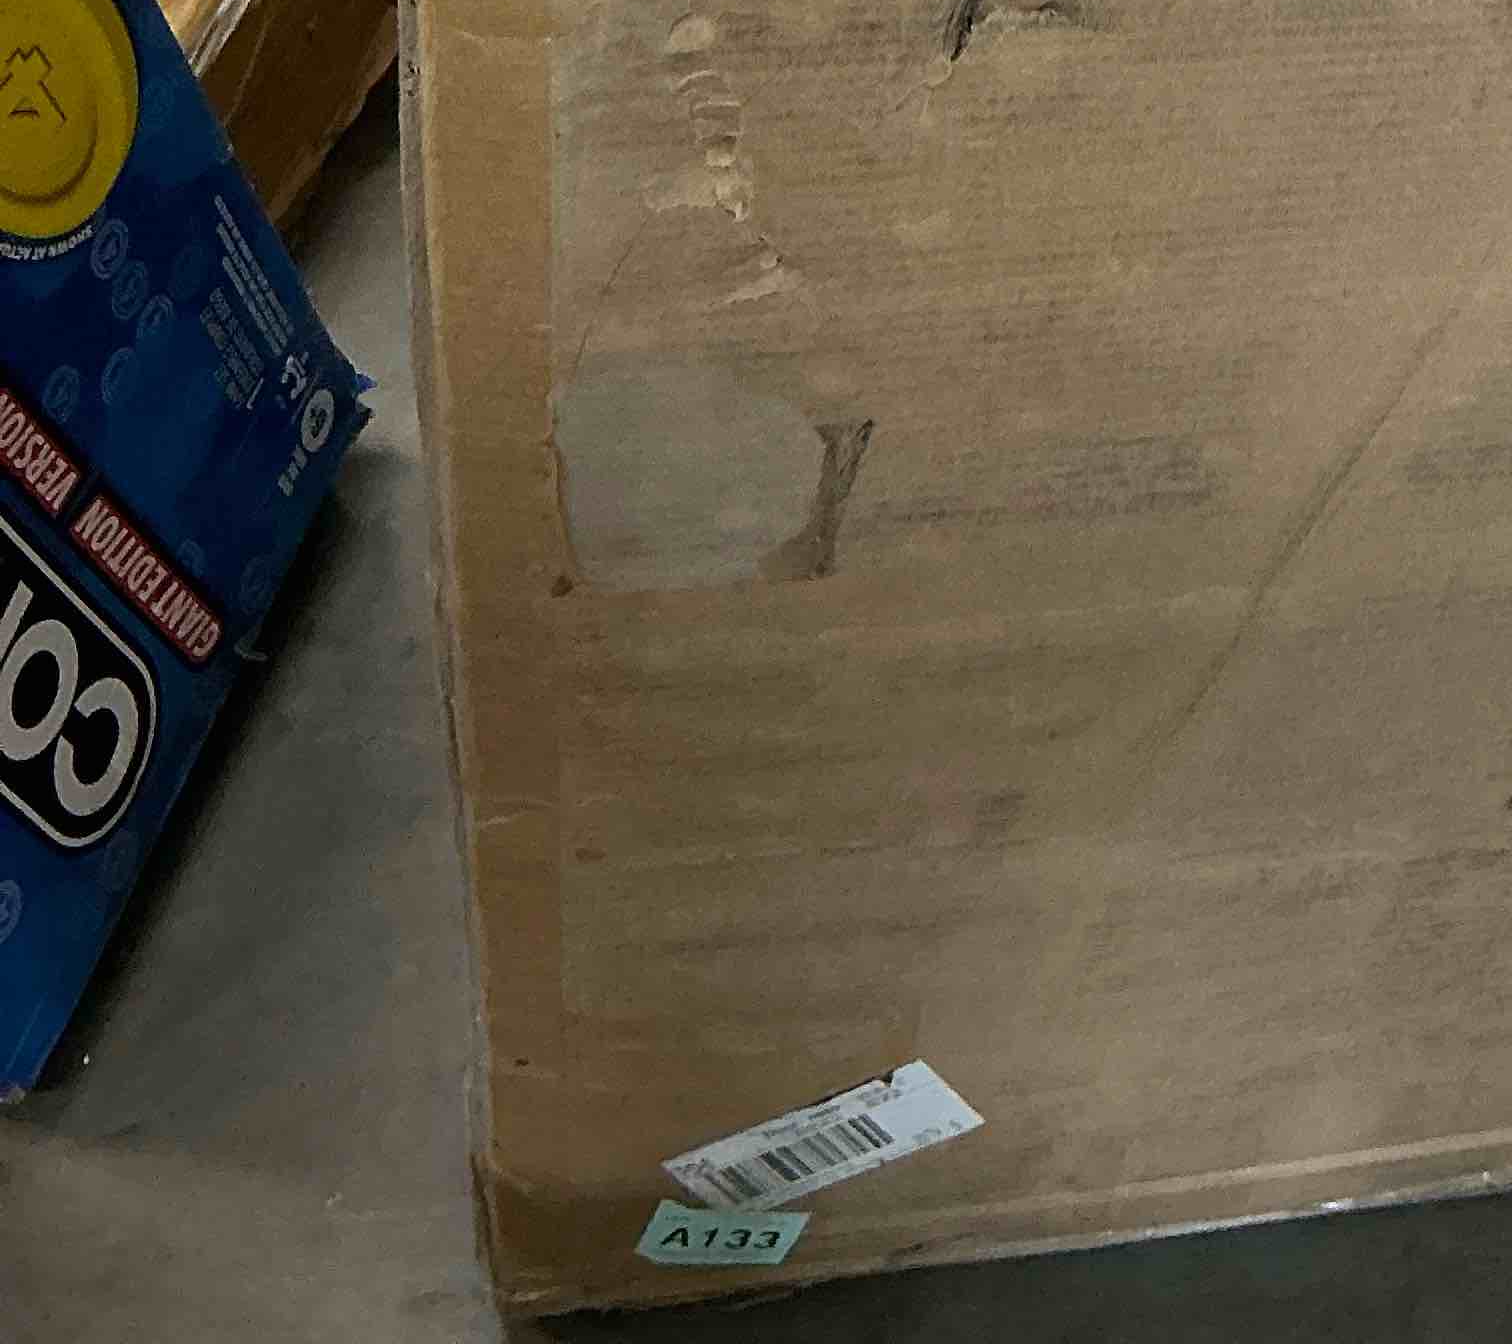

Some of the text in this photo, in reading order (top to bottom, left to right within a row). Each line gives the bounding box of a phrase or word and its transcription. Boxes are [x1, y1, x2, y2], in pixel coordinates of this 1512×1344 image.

[75, 496, 222, 657] GIANT EDITION
[659, 1225, 782, 1250] A133
